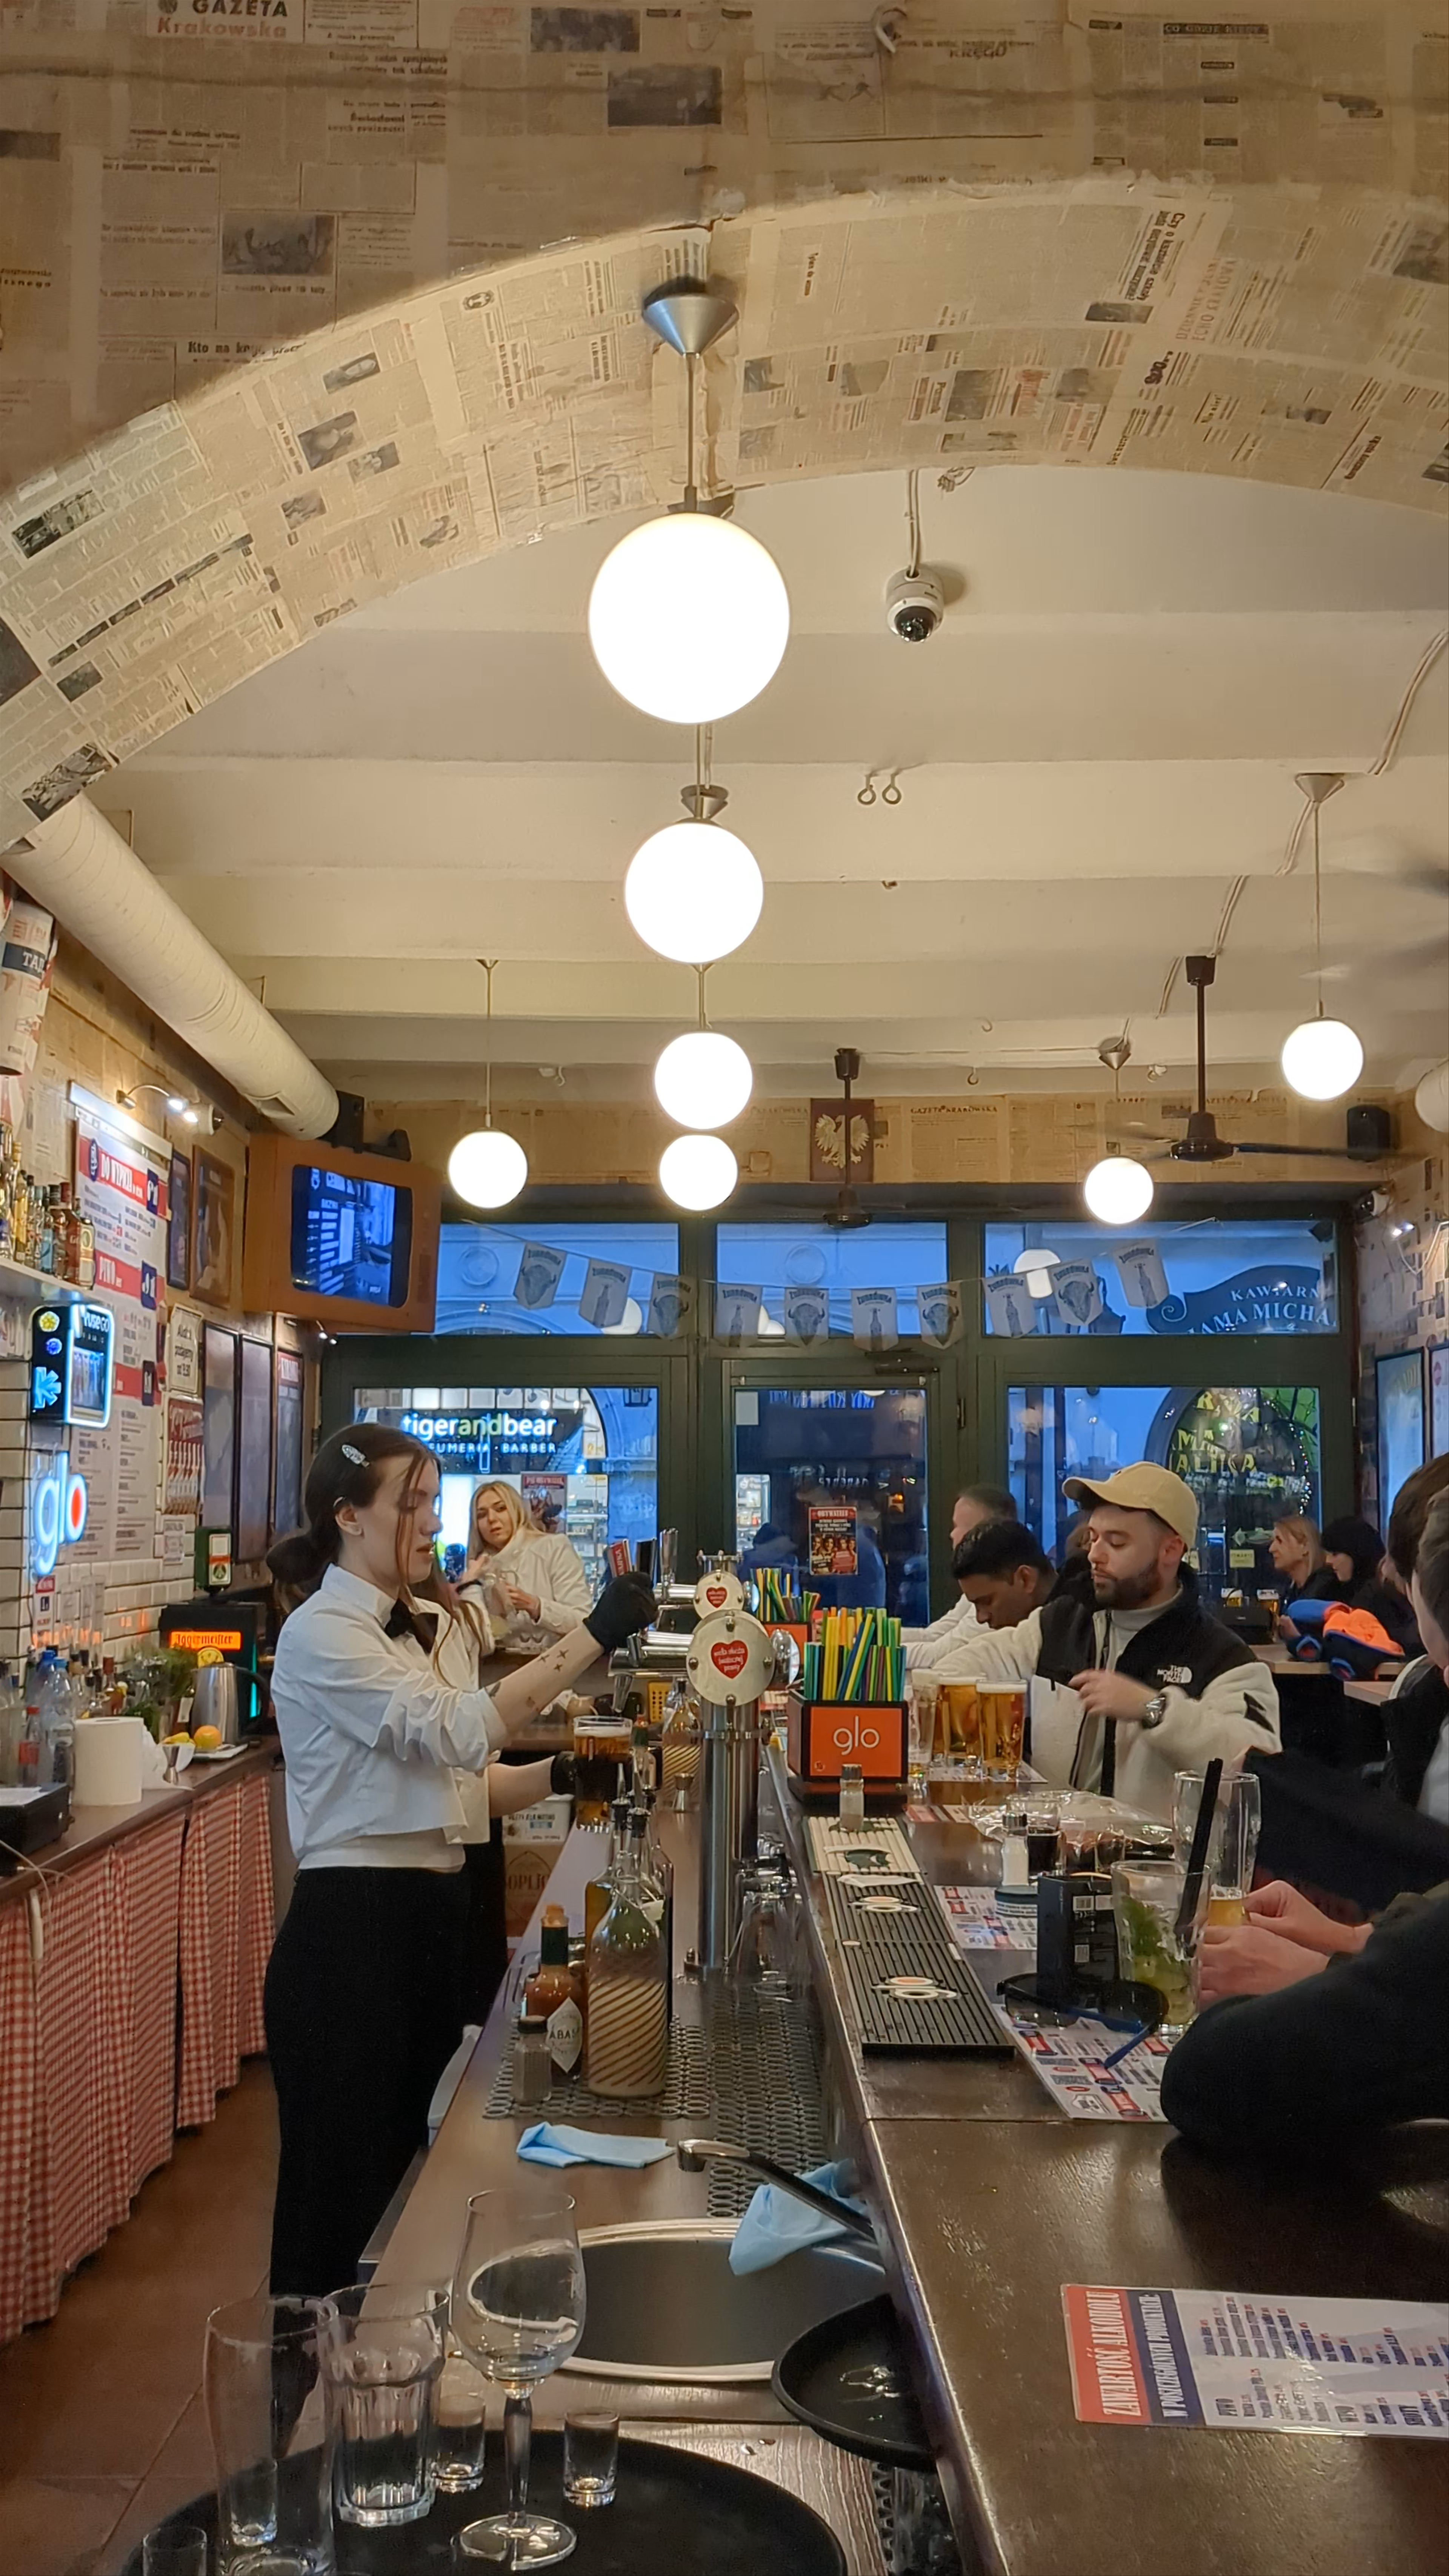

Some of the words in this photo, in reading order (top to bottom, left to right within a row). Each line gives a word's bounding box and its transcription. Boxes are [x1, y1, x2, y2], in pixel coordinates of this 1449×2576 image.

[192, 0, 288, 17] GAZETA
[157, 17, 287, 38] Krakowska
[188, 341, 209, 354] Kto
[401, 1412, 557, 1441] tigerandbear
[501, 1443, 556, 1453] BARBER
[833, 1714, 880, 1756] glo
[1086, 2291, 1128, 2347] ALKOHOLU
[1086, 2347, 1141, 2416] ZAWARTOŚĆ
[1149, 2342, 1186, 2408] POSZCZEGÓLNYCH
[1163, 2409, 1188, 2417] W
